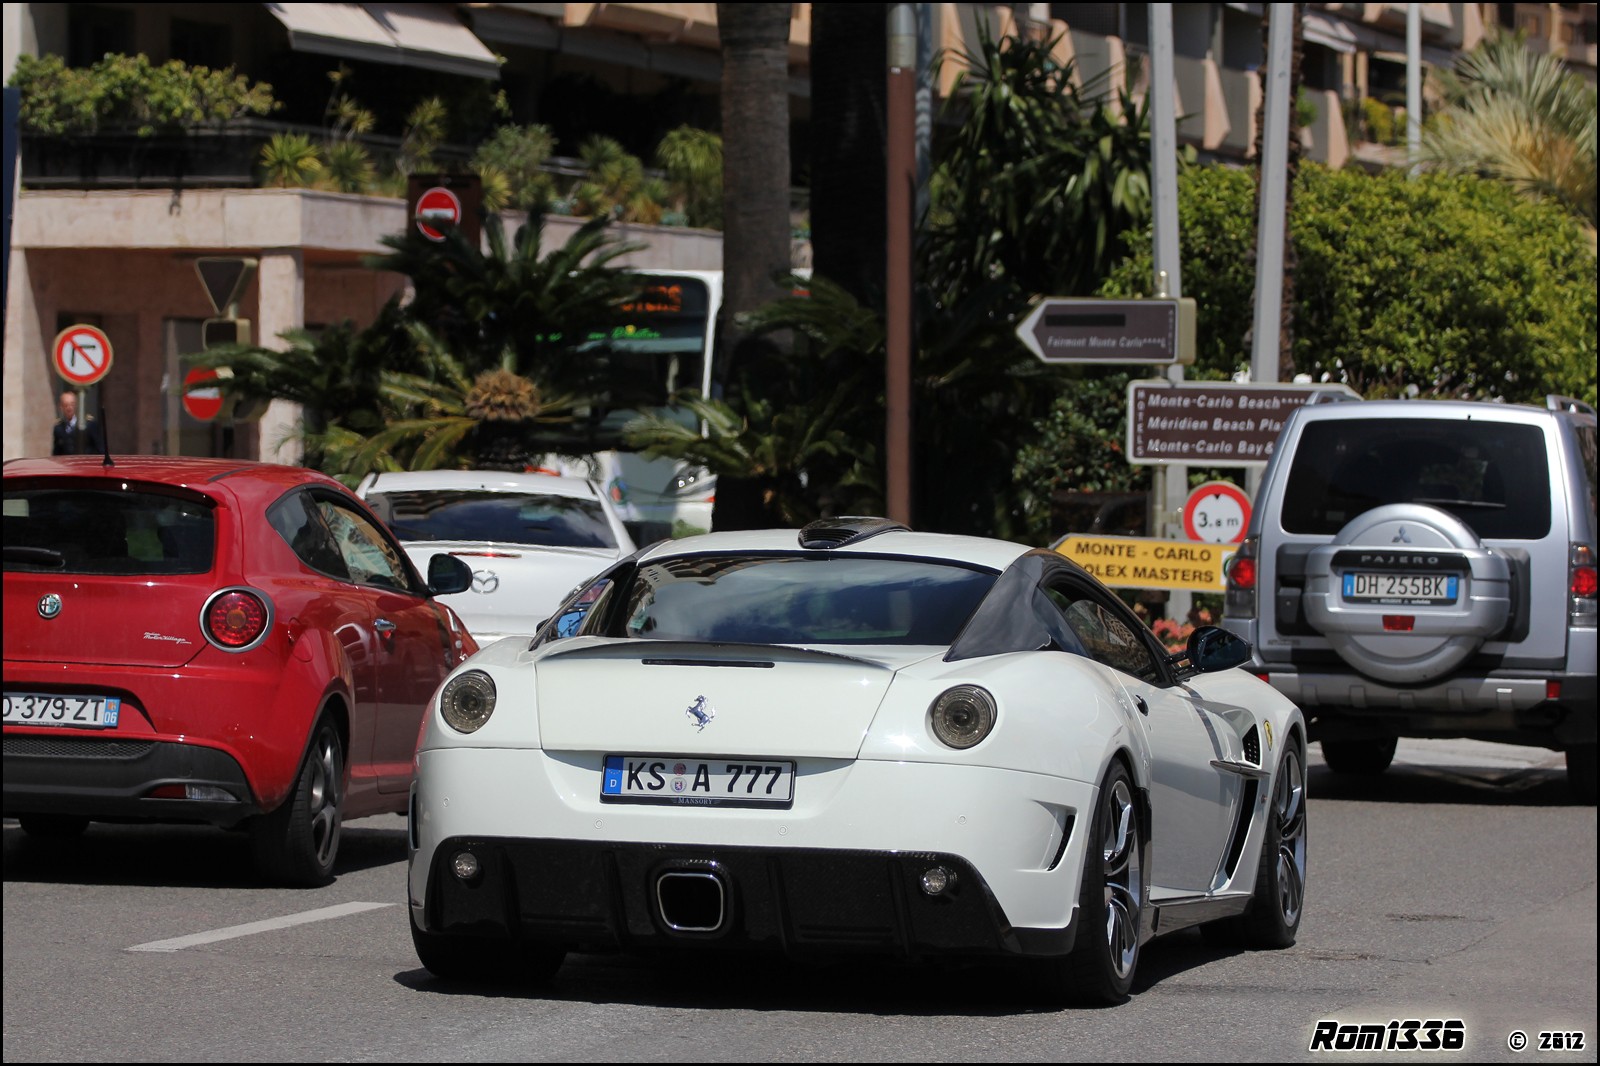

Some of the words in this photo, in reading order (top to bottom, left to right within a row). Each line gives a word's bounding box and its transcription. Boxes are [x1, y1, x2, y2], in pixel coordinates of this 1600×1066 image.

[1088, 335, 1116, 348] Monte
[1147, 393, 1234, 409] Monte-Carlo
[1147, 416, 1209, 431] Méridien
[1212, 417, 1255, 432] Beach
[1259, 418, 1286, 432] Pla
[1147, 438, 1233, 454] Monte-Carlo
[1075, 541, 1136, 558] MONTE
[1153, 546, 1212, 562] CARLO
[1360, 555, 1439, 564] PAJERO
[1080, 563, 1127, 578] OLEX
[1132, 565, 1214, 583] MASTERS
[1356, 575, 1379, 594] DH
[1386, 576, 1444, 596] 255BK
[104, 711, 118, 724] 06
[609, 779, 617, 788] D
[626, 761, 666, 791] KS
[691, 763, 711, 792] A
[725, 764, 783, 794] 777
